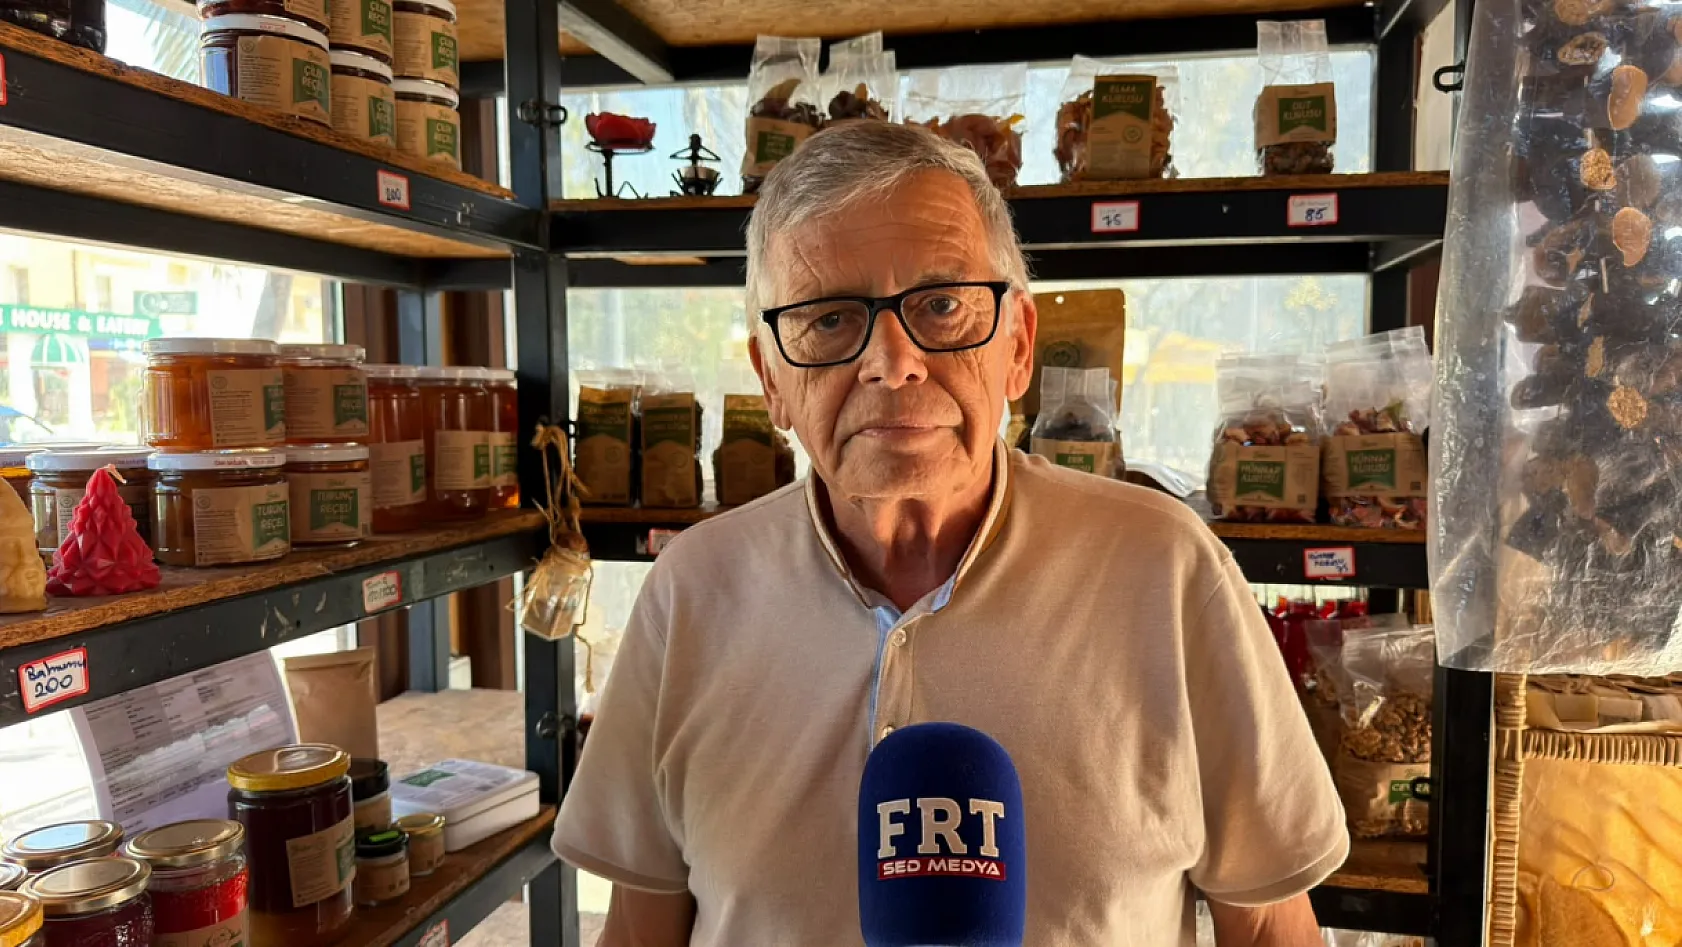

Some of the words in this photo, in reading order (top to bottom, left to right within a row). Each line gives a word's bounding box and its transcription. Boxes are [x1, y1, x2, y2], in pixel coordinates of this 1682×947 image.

[1102, 213, 1122, 227] 75
[1305, 207, 1328, 222] 85
[11, 308, 71, 330] HOUSE
[77, 317, 91, 332] &
[35, 674, 73, 698] 200
[877, 797, 1005, 859] FRT
[883, 860, 921, 876] SED
[927, 859, 1001, 876] MEDYA
